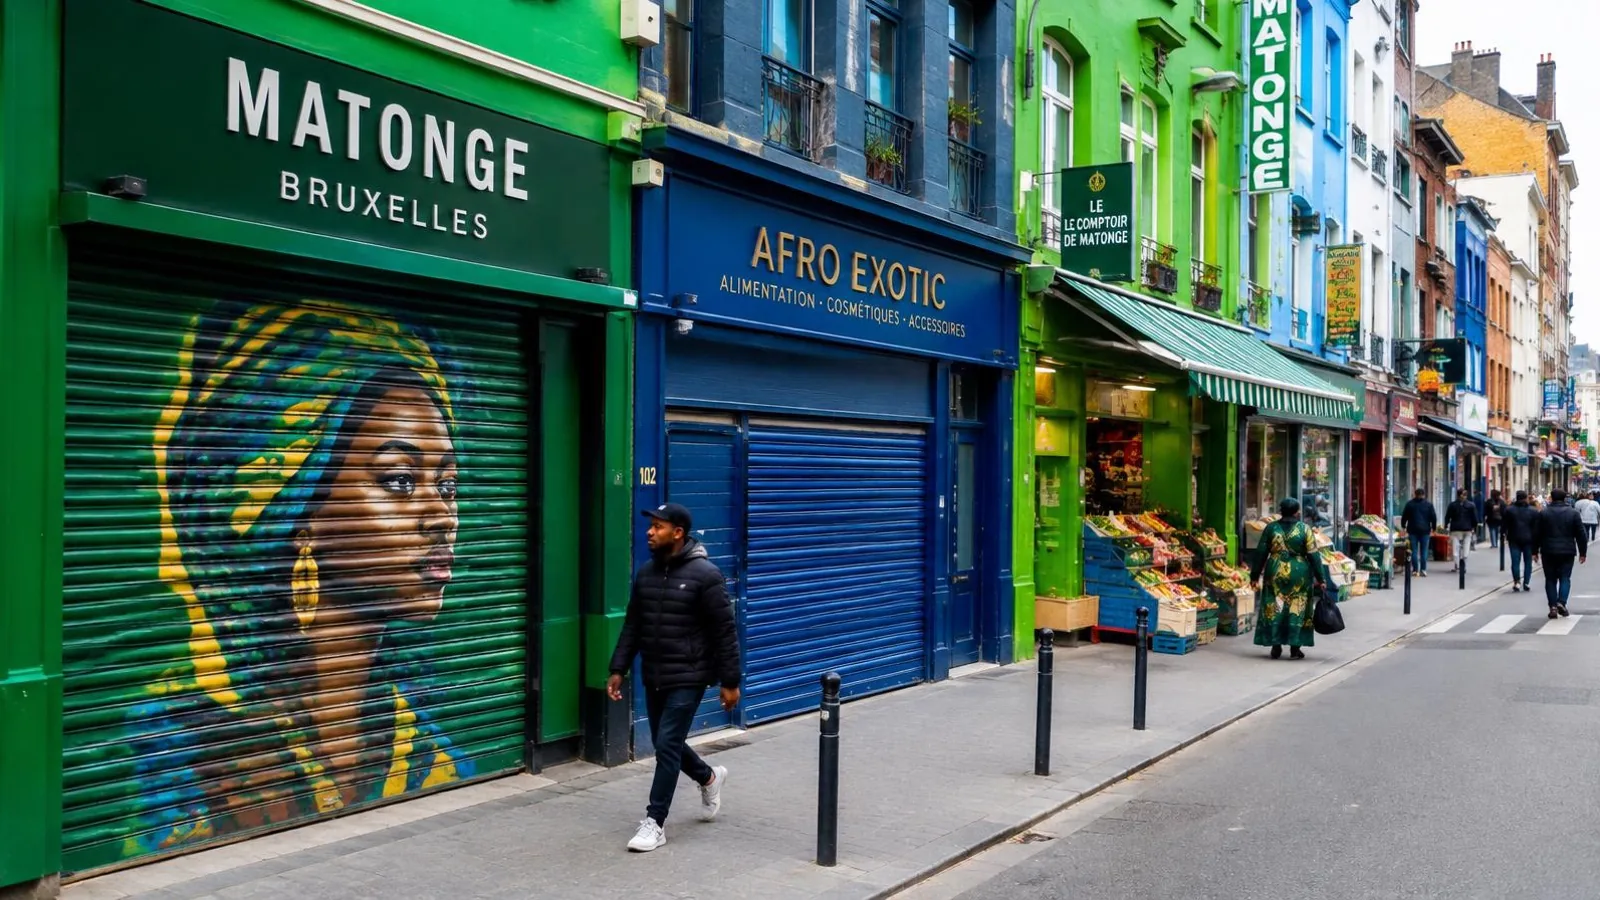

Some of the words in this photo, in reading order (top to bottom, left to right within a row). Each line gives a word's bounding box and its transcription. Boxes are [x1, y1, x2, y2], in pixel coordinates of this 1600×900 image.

[1252, 0, 1288, 190] MATONGE
[226, 56, 529, 201] MATONGE
[280, 170, 488, 240] BRUXELLES
[1064, 218, 1075, 231] LE
[1077, 215, 1128, 230] COMPTOIR
[1090, 199, 1103, 213] LE
[751, 226, 841, 286] AFRO
[851, 251, 946, 310] EXOTIC
[1064, 233, 1077, 247] DE
[1079, 230, 1128, 246] MATONGE
[719, 274, 815, 309] ALIMENTATION
[826, 296, 900, 326] COSMÉTIQUES
[908, 314, 966, 339] ACCESSOIRES
[640, 467, 656, 485] 102
